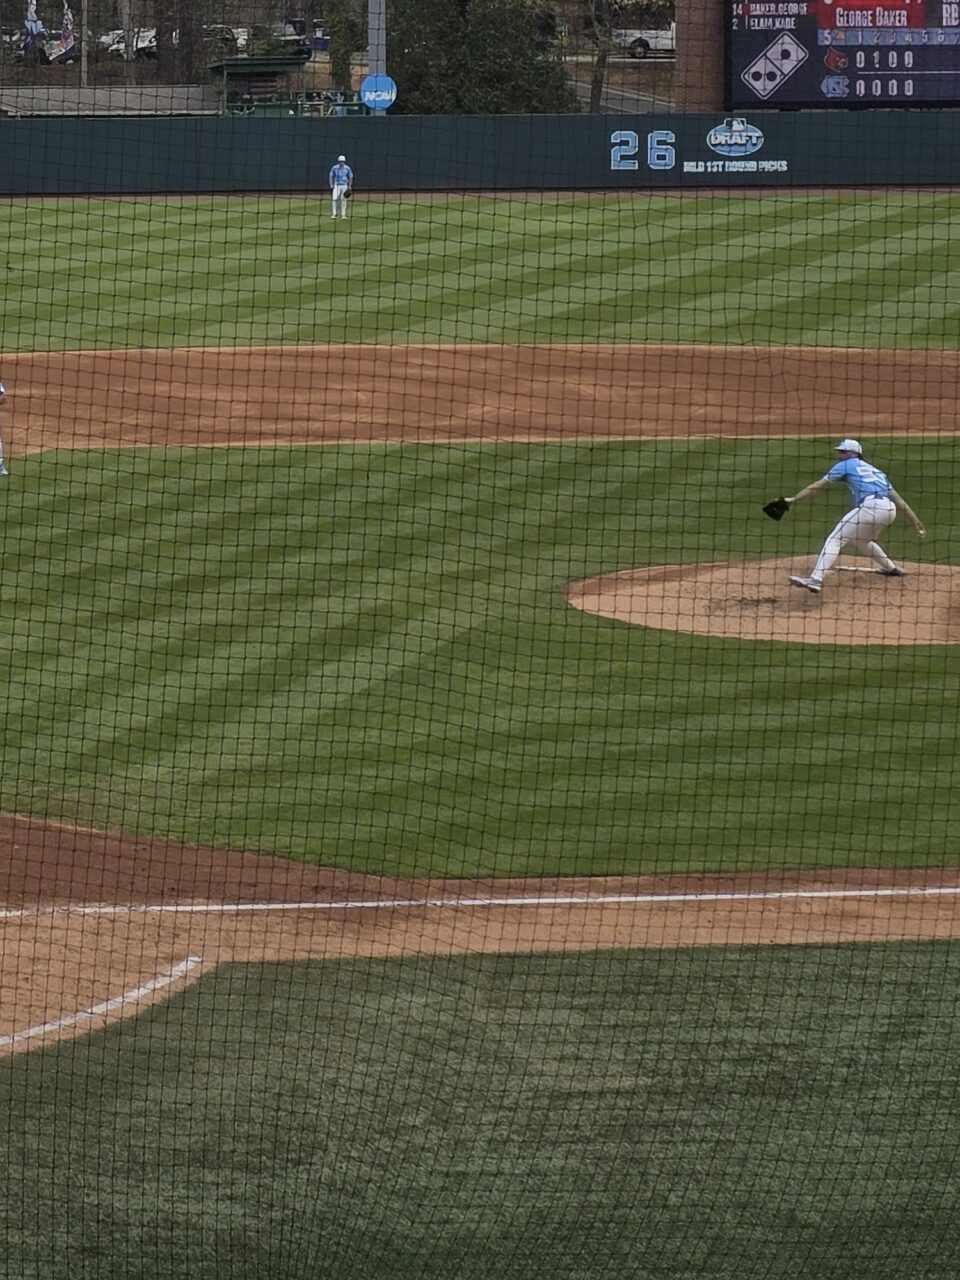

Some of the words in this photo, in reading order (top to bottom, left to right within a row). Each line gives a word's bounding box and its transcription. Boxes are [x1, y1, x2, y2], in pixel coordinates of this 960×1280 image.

[732, 3, 743, 16] 14
[732, 18, 738, 30] 2
[823, 30, 832, 45] 5
[856, 51, 865, 68] 0
[888, 51, 897, 68] 0
[904, 51, 913, 68] 0
[872, 79, 881, 96] 0
[888, 79, 897, 96] 0
[904, 79, 913, 96] 0
[711, 132, 762, 145] DRAFT
[610, 130, 676, 170] 26
